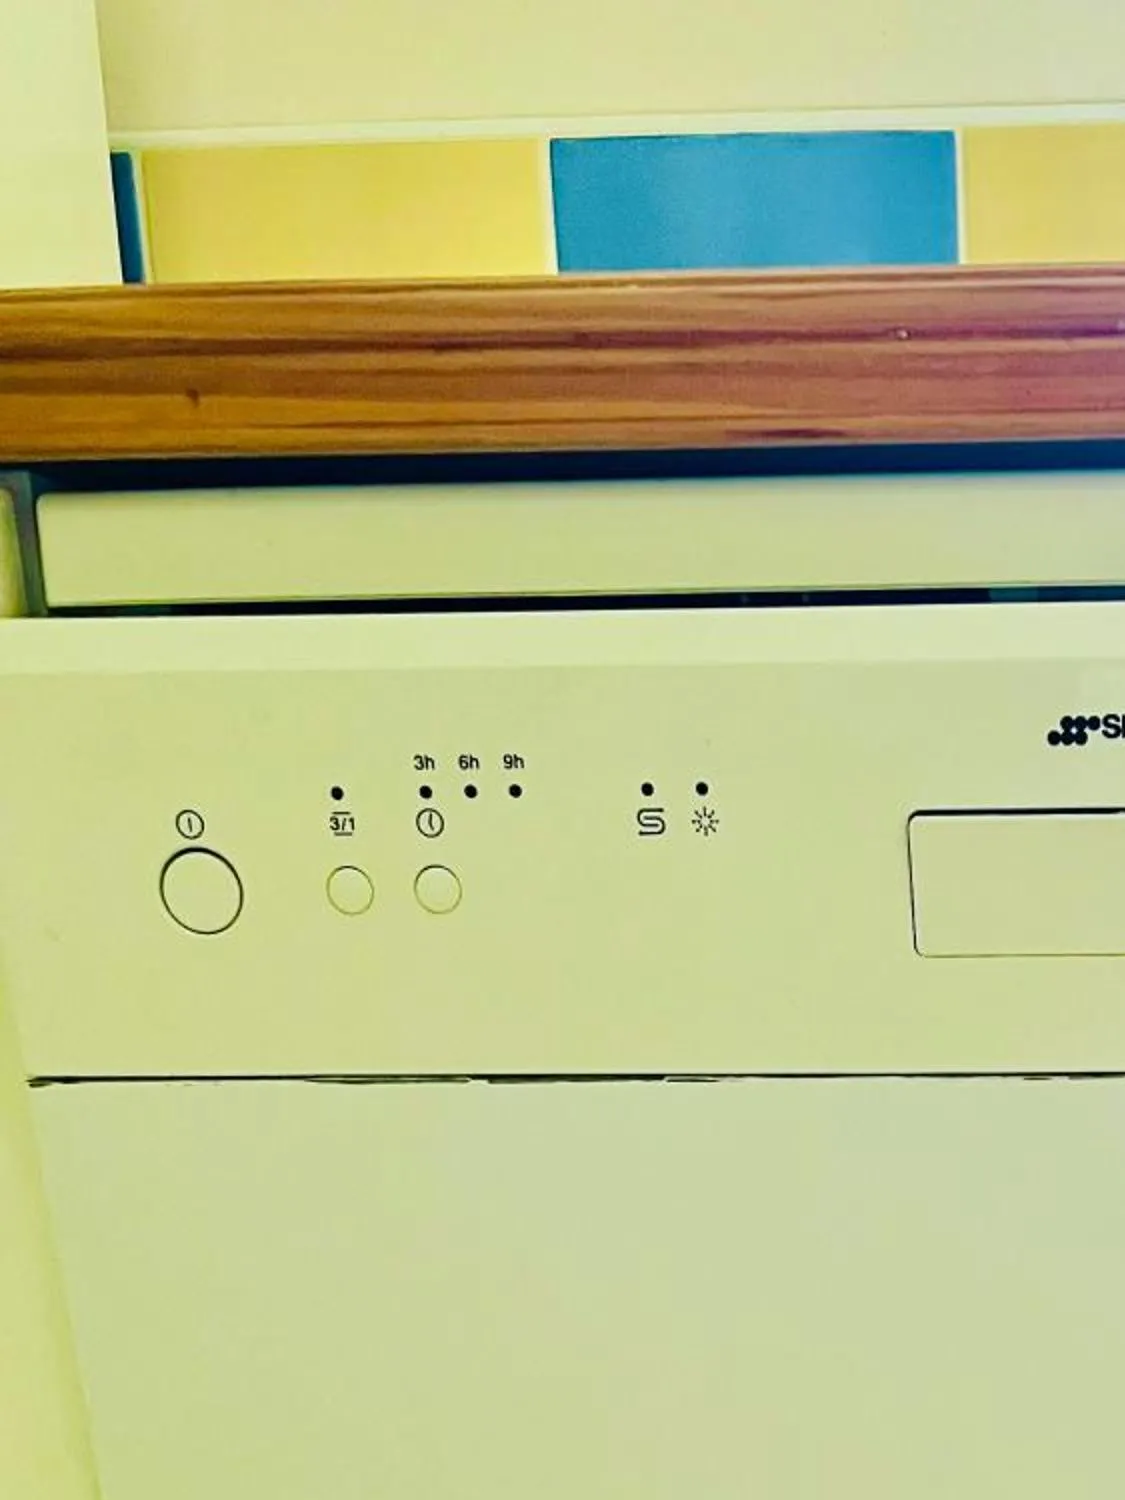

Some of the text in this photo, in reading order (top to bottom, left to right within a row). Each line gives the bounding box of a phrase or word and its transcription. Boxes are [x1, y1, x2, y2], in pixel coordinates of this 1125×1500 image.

[413, 753, 526, 771] 3h 6h 9h
[329, 815, 356, 832] 3/1
